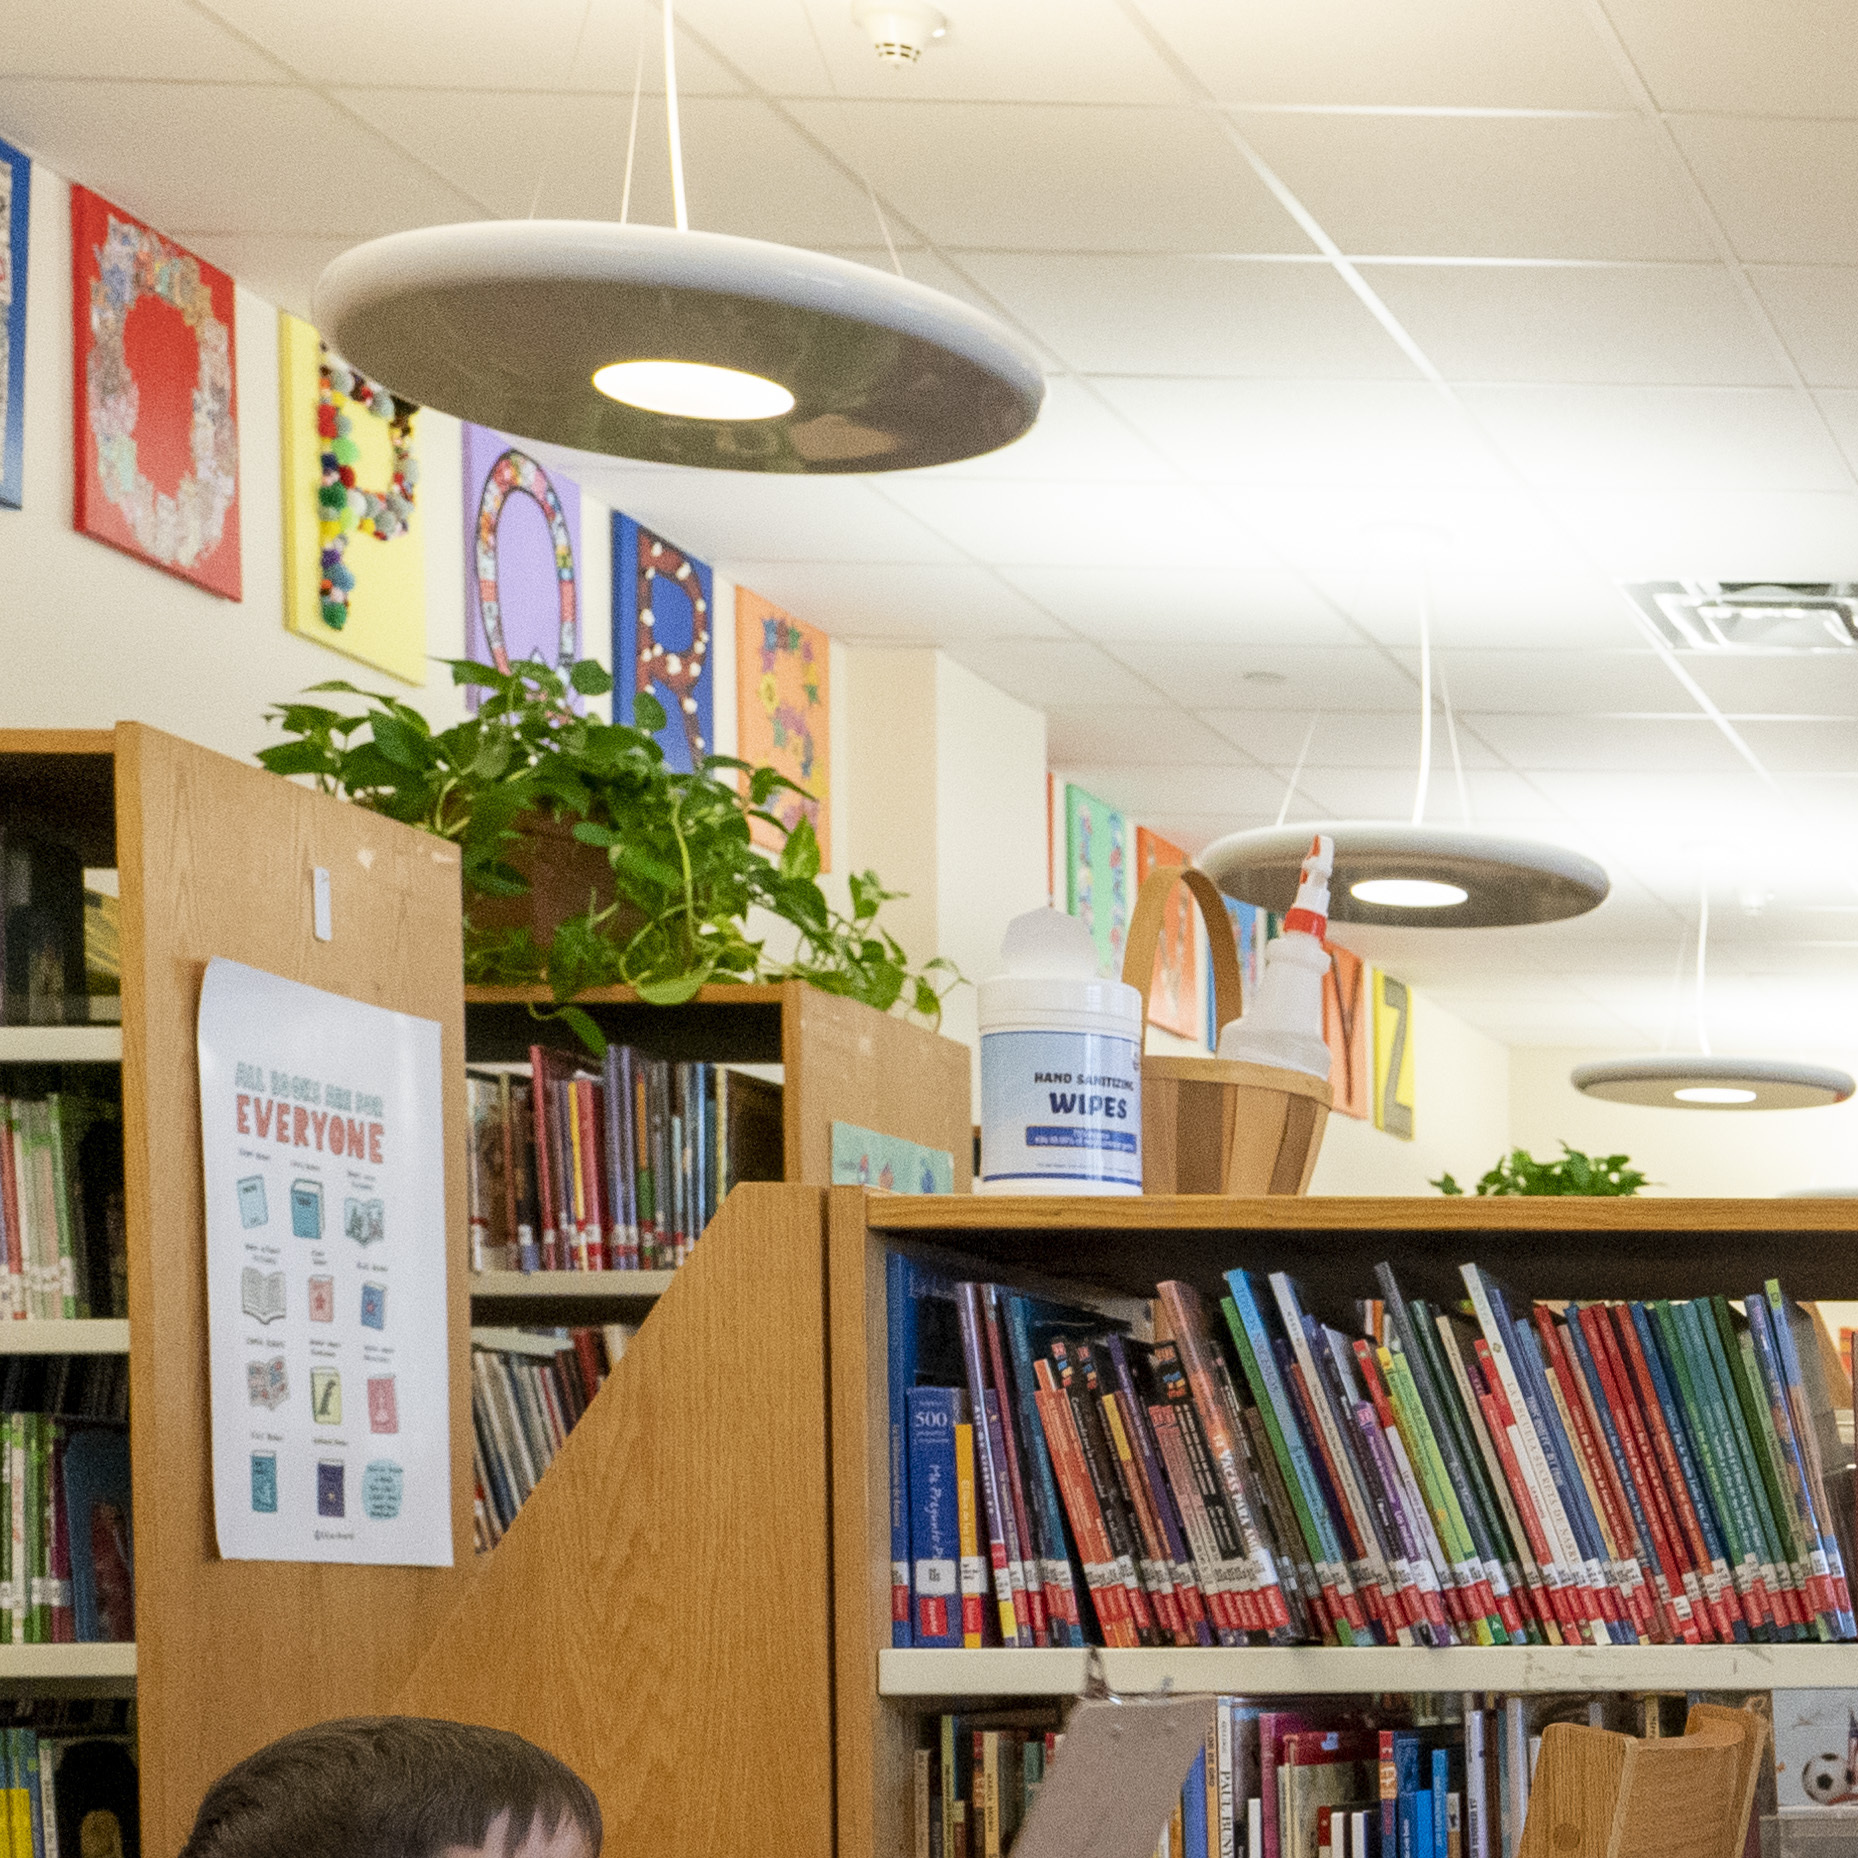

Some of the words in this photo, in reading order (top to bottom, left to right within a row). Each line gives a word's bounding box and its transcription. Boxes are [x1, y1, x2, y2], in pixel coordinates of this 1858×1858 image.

[1034, 1073, 1072, 1083] HAND
[1048, 1092, 1127, 1119] WIPES
[236, 1094, 384, 1164] EVERYONE
[914, 1411, 947, 1427] 500
[1215, 1446, 1242, 1493] VACAS
[1230, 1491, 1252, 1526] PARA
[1219, 1770, 1232, 1817] PAUL
